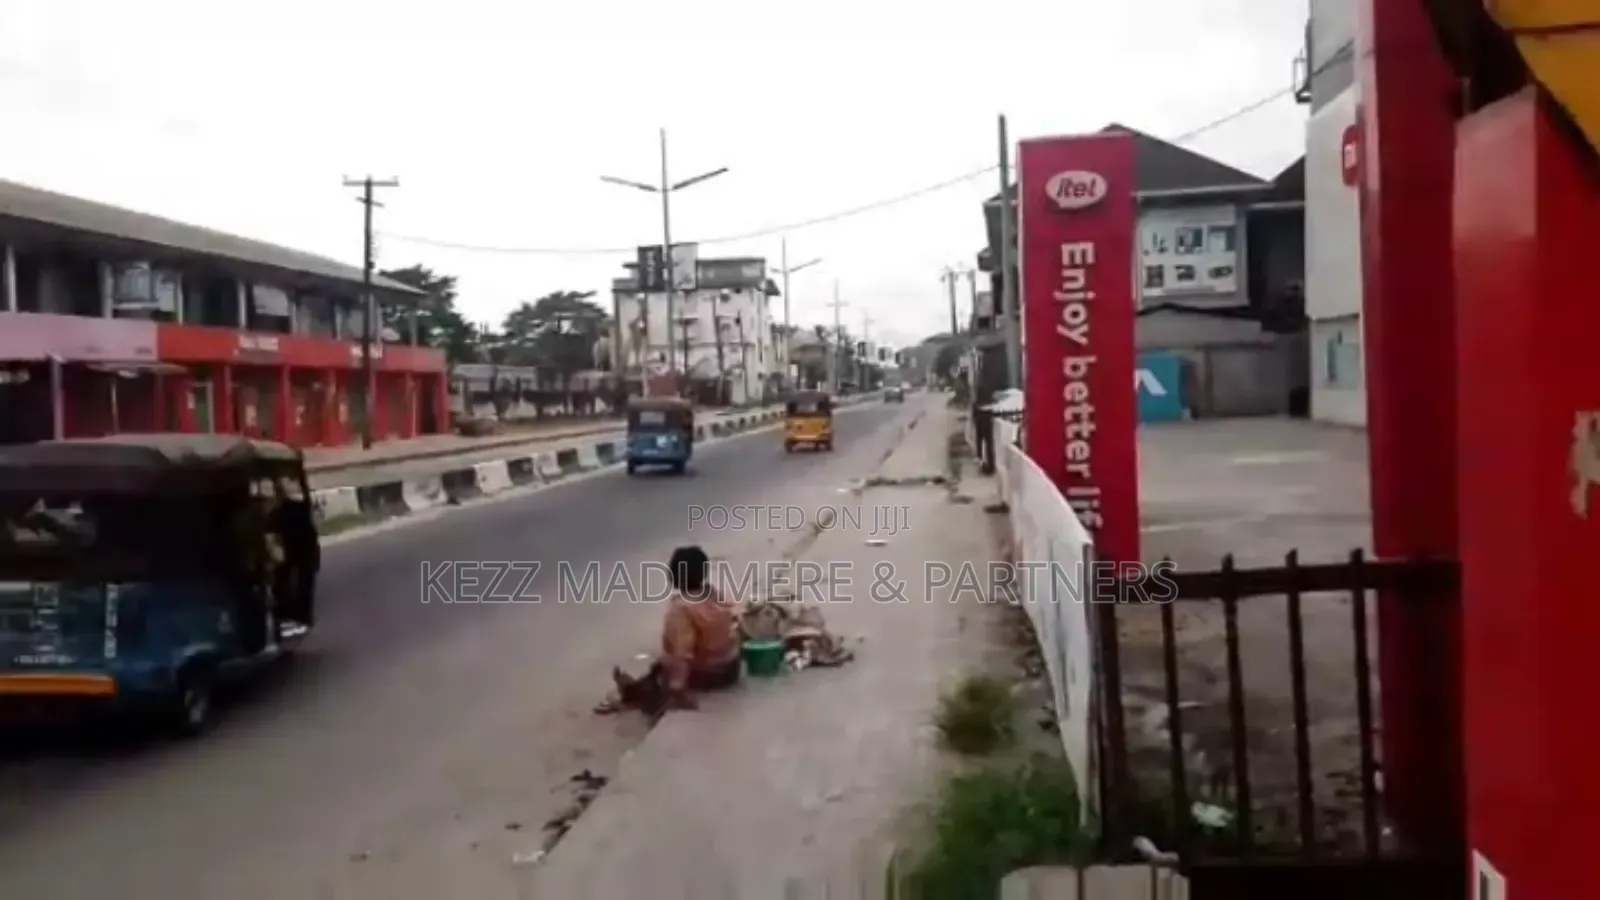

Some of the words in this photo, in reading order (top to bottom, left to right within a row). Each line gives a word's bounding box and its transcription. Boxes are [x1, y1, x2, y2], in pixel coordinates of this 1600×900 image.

[1057, 176, 1097, 199] itel
[1054, 241, 1096, 345] Enjoy
[1063, 356, 1098, 478] better
[1067, 486, 1104, 530] lif
